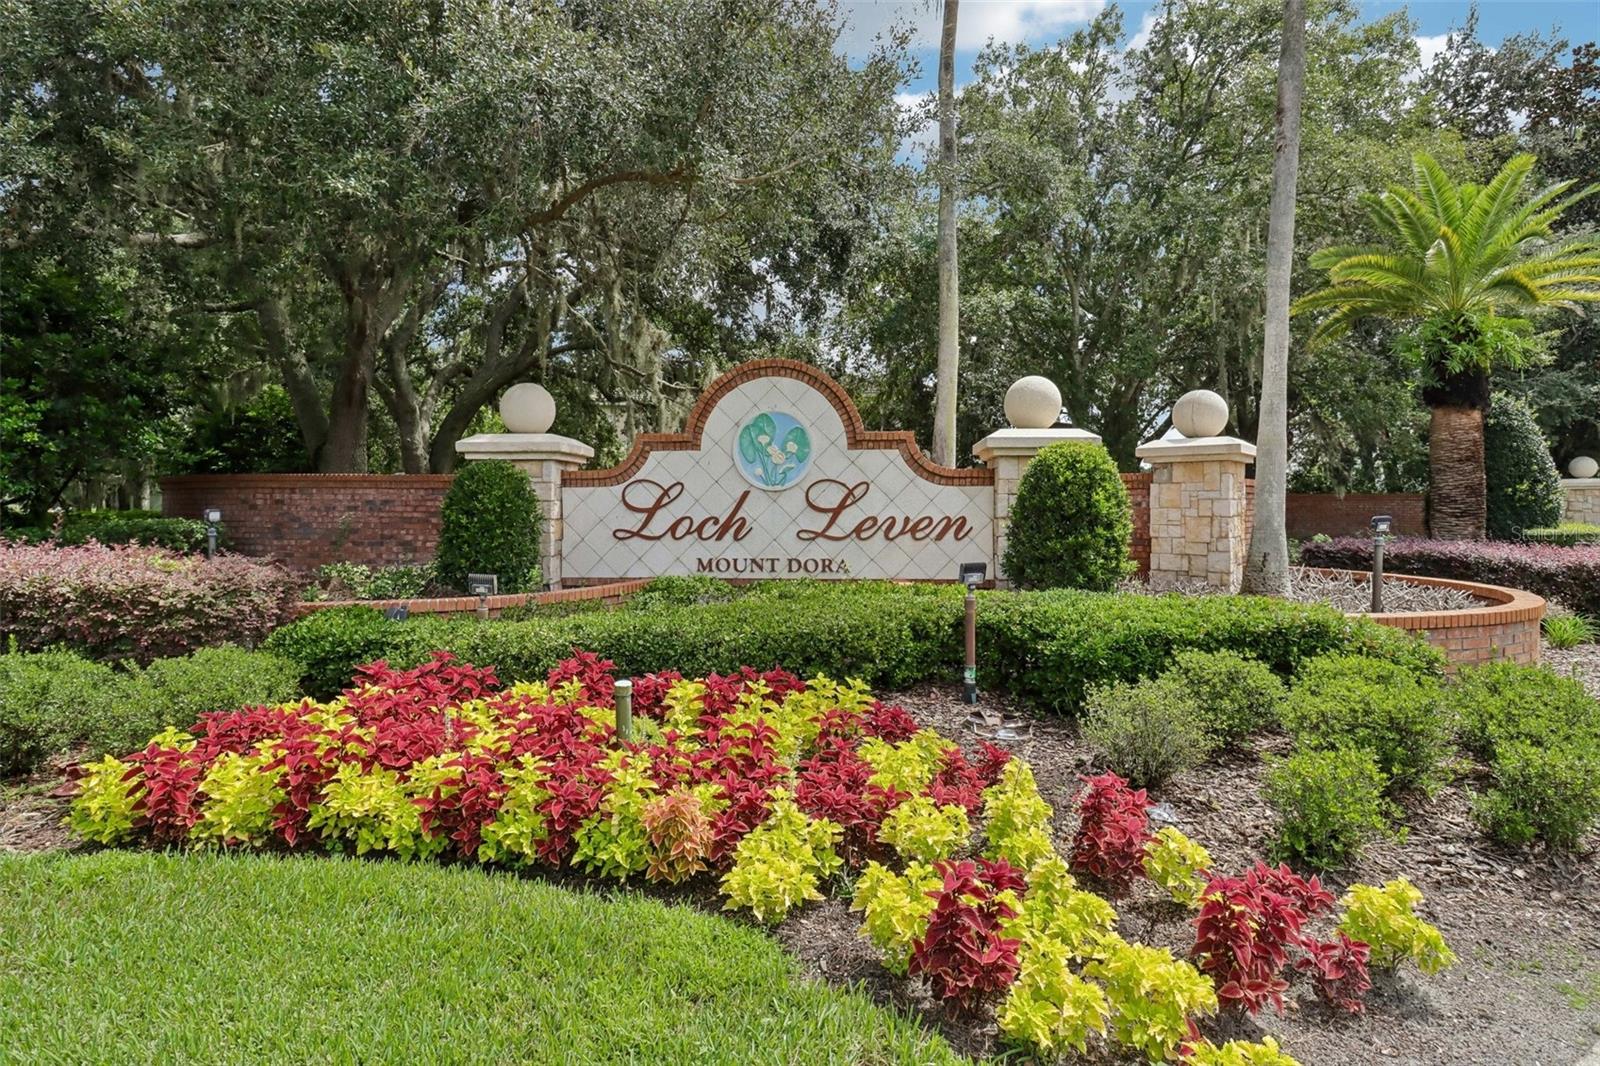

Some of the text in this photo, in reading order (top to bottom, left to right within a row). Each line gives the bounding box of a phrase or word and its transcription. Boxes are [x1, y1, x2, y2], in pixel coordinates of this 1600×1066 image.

[612, 479, 973, 542] Loch Leven
[696, 557, 850, 574] MOUNT DORA
